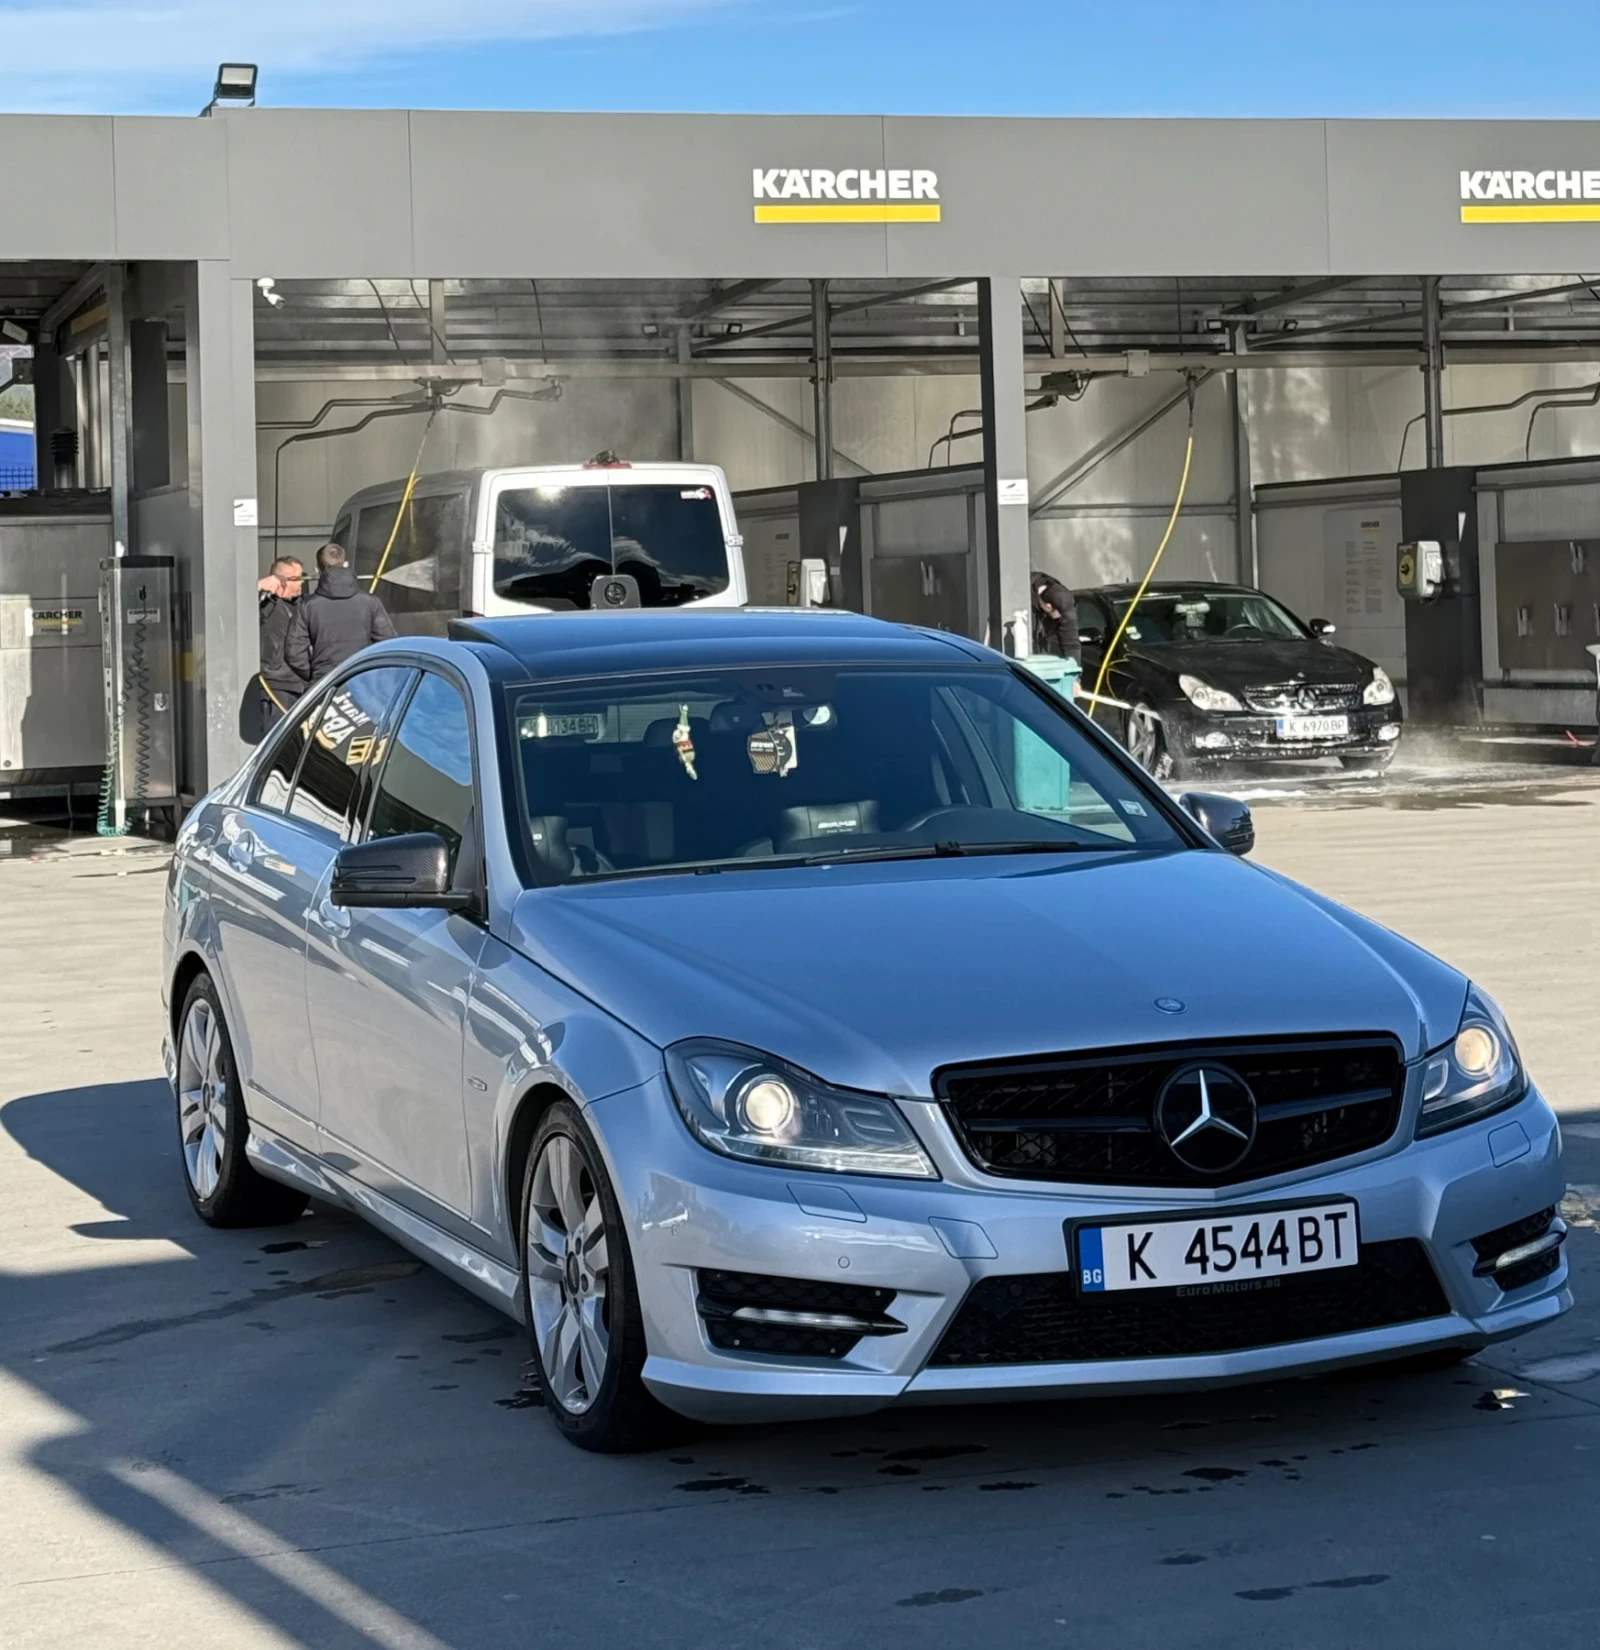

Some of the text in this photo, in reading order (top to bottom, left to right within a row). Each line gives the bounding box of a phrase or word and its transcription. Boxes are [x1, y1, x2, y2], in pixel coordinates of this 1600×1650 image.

[752, 168, 940, 199] KÄRCHER
[1460, 170, 1600, 199] KÄRCHE
[1127, 1211, 1348, 1281] K 4544BT
[1082, 1269, 1103, 1285] BG
